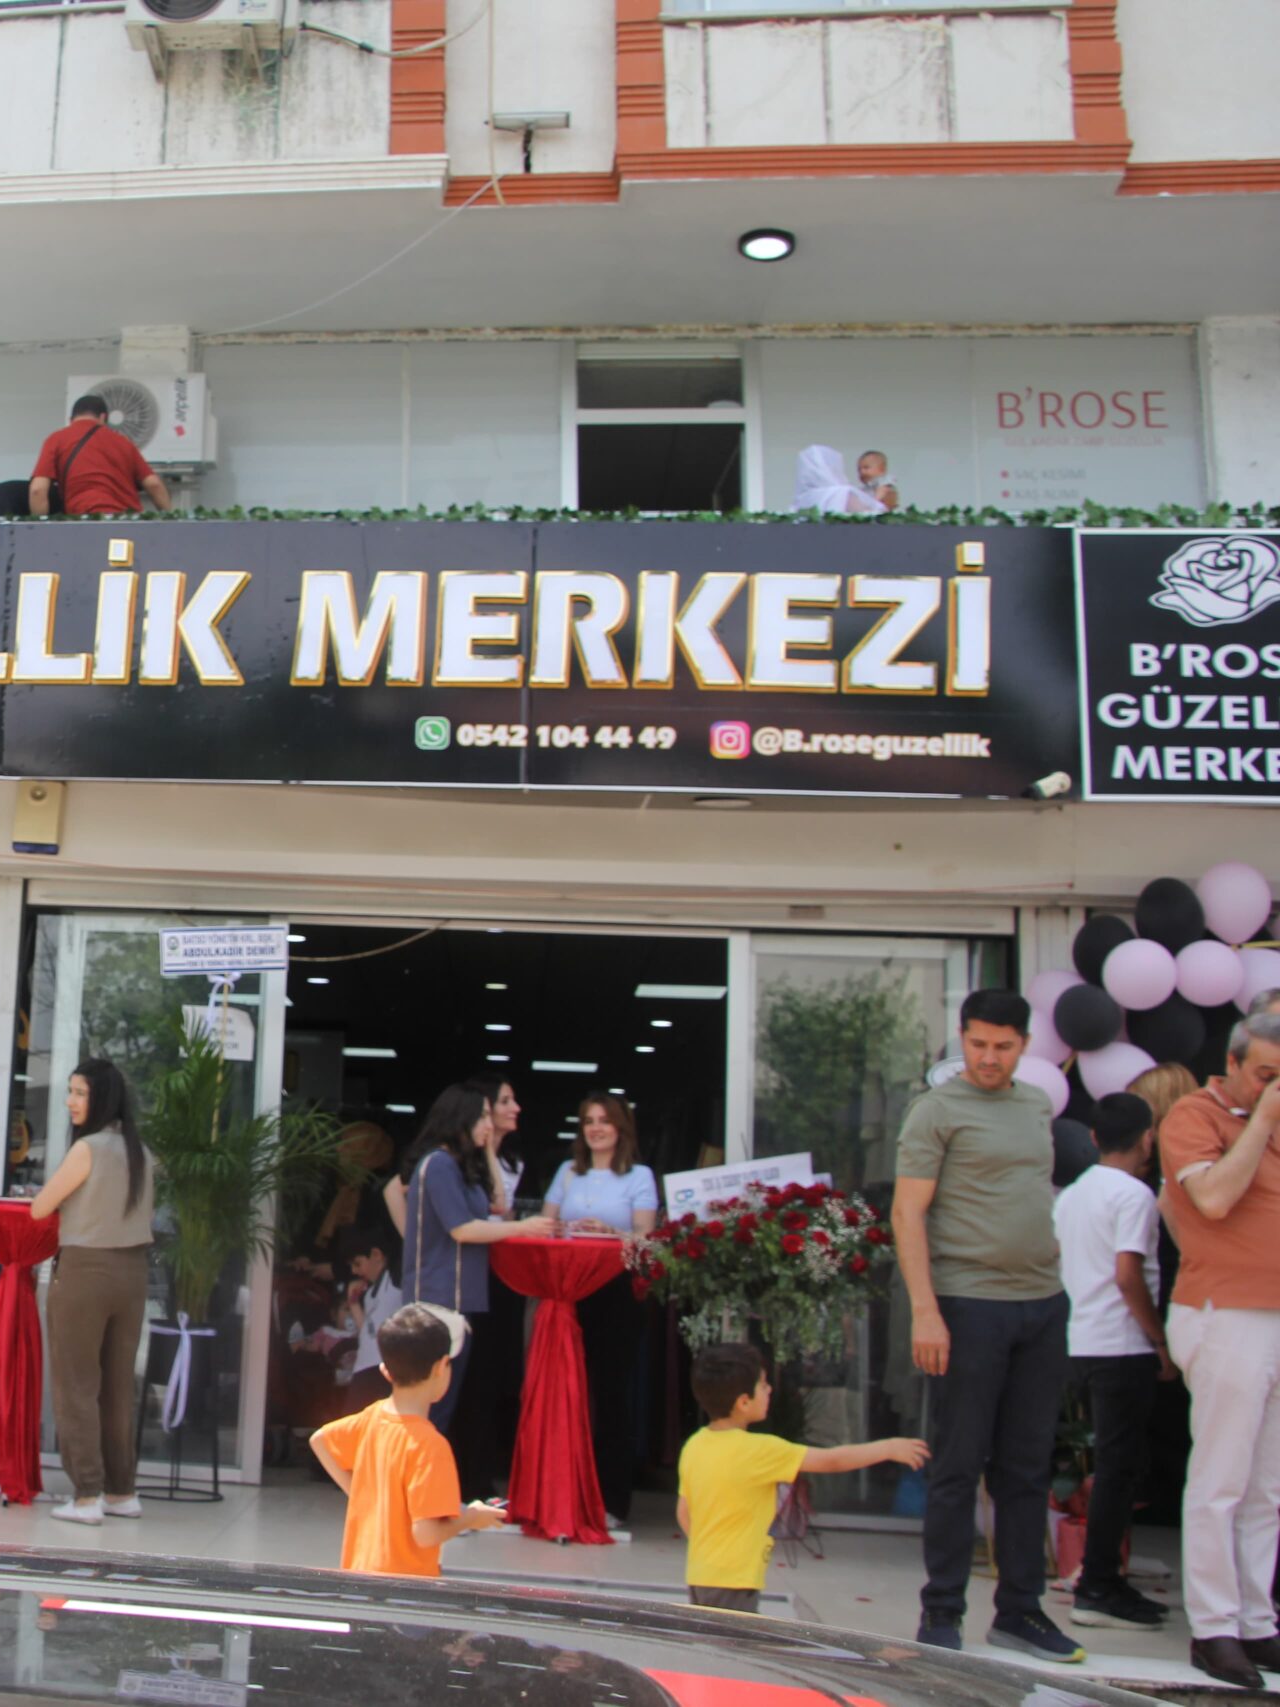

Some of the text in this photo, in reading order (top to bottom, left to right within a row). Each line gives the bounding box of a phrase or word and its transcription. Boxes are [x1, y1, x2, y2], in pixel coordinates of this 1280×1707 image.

[996, 386, 1169, 430] B'ROSE
[290, 541, 991, 697] MERKEZİ
[456, 723, 677, 749] 0542 104 44 49
[752, 726, 991, 761] @B.roseguzellik
